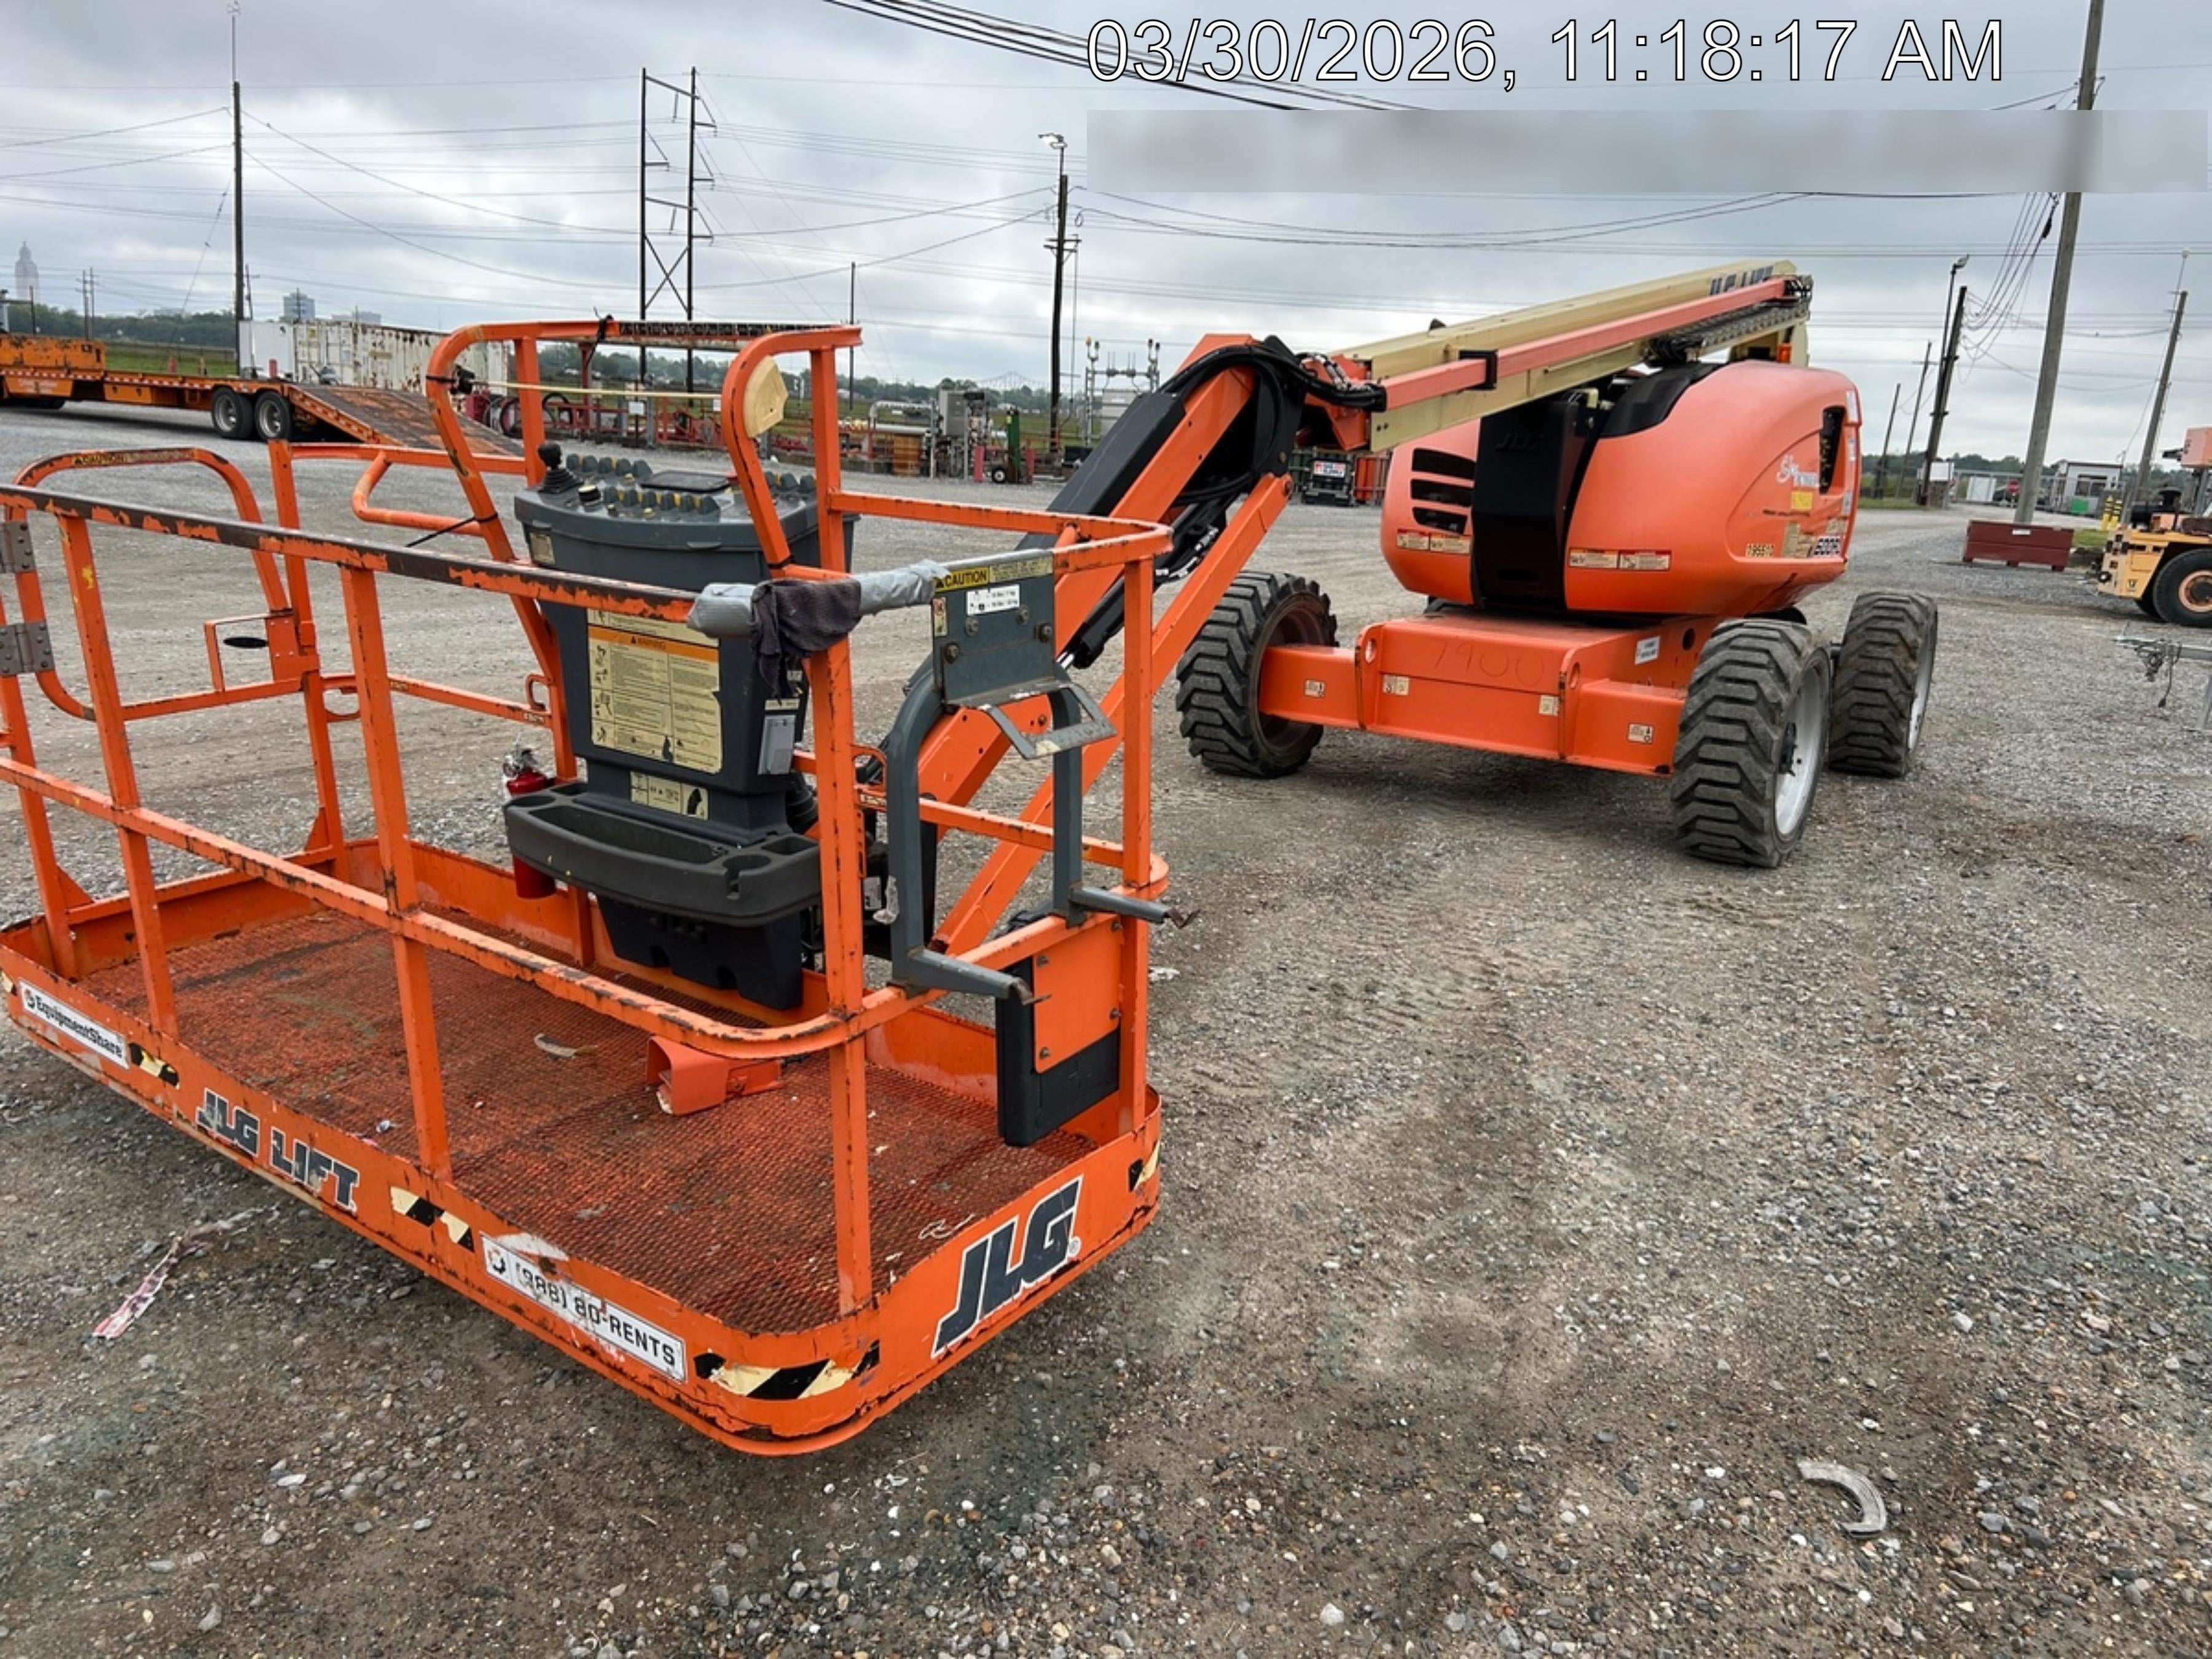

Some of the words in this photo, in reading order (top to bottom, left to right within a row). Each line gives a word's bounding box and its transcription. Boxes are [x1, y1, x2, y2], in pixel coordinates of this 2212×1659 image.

[944, 569, 987, 587] CAUTION
[34, 994, 123, 1059] EquipmentShare
[196, 1088, 260, 1158] JLG
[270, 1126, 359, 1212] LIFT
[930, 1173, 1084, 1360] JLG
